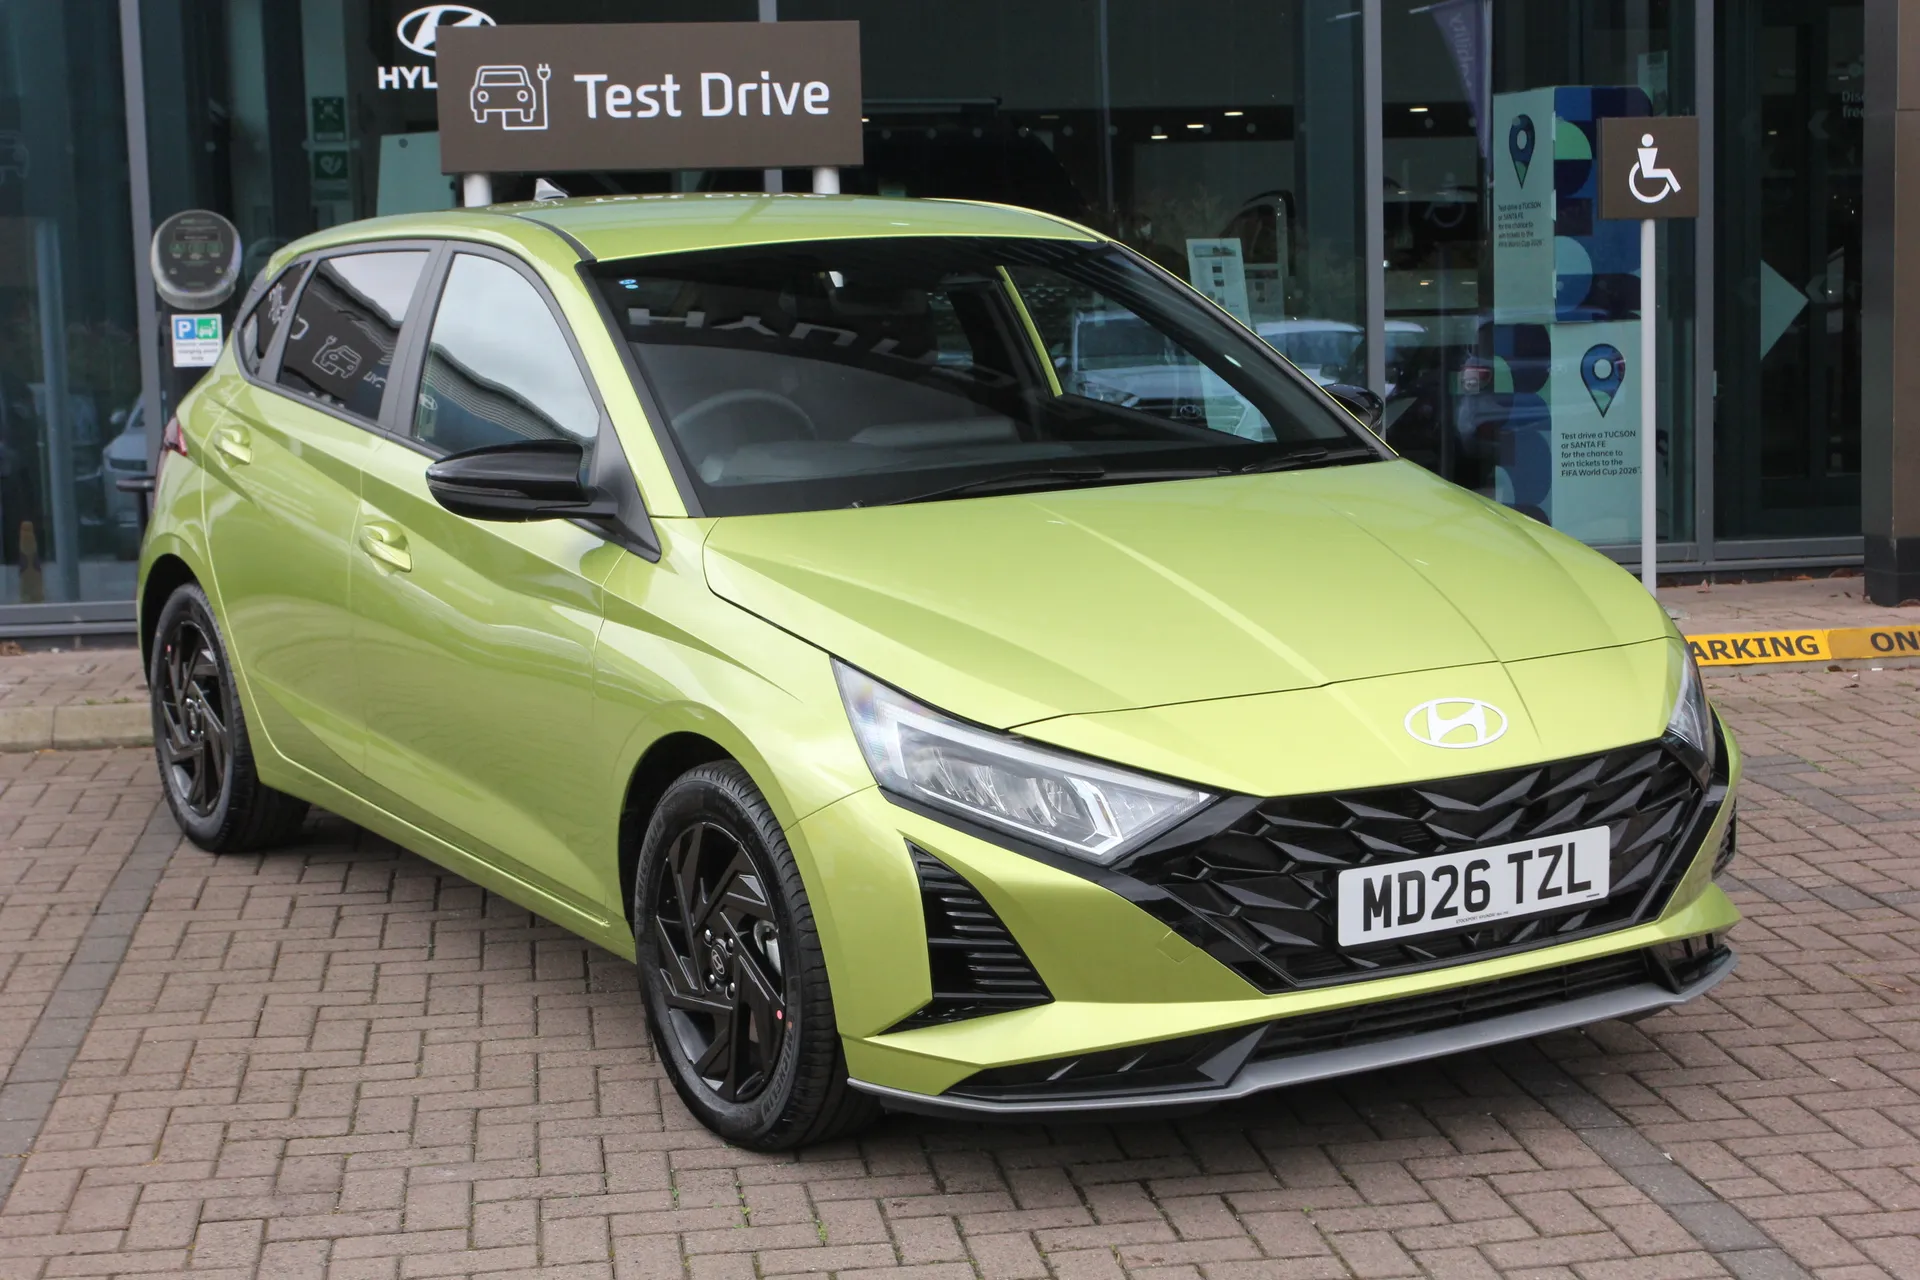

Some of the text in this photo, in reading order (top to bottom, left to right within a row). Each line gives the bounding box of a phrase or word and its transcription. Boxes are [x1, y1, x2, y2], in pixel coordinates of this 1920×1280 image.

[574, 71, 830, 119] Test Drive
[178, 320, 191, 338] P
[1604, 430, 1636, 438] TUCSON
[1688, 631, 1920, 661] ARKING ON
[1363, 841, 1592, 932] MD26 TZL
